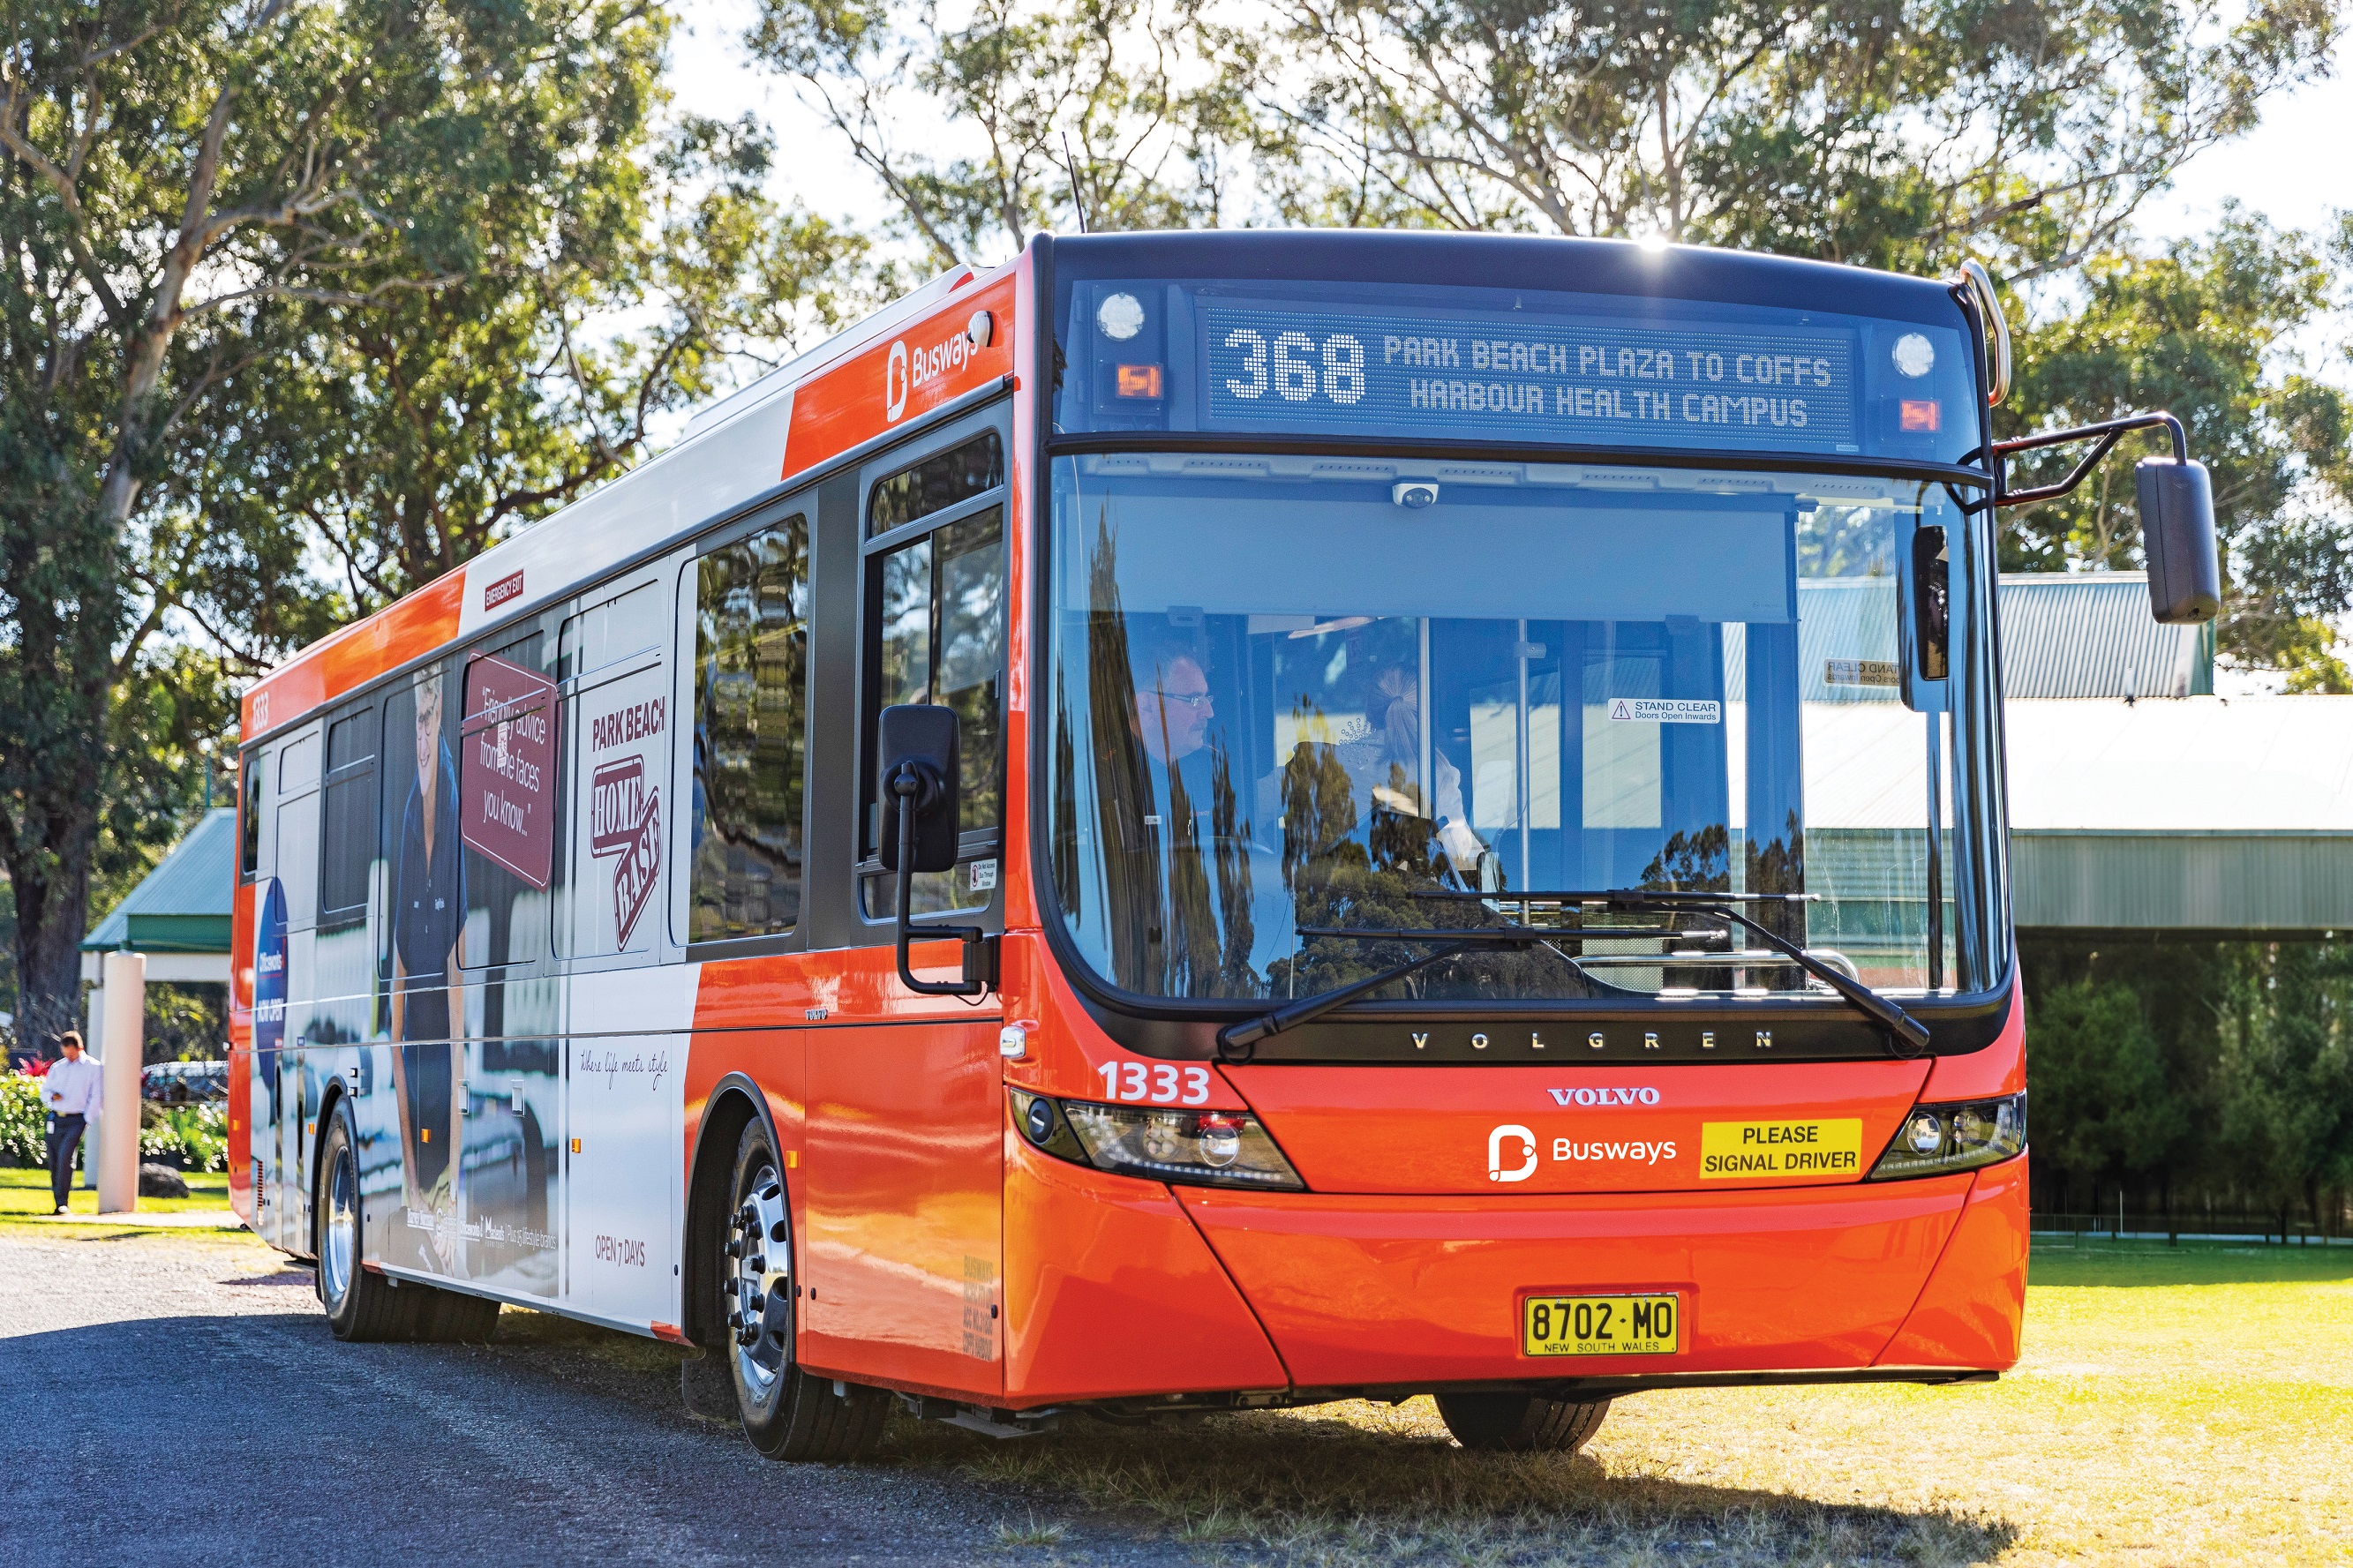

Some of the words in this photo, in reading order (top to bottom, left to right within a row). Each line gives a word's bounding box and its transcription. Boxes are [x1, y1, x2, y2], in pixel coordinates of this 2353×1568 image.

[1225, 327, 1366, 405] 368
[1383, 334, 1461, 369] PARK
[1472, 338, 1568, 374] BEACH
[1579, 343, 1674, 379] PLAZA
[1687, 349, 1725, 382] TO
[1735, 353, 1833, 387] COFFS
[1411, 376, 1544, 414] HARBOUR
[1557, 385, 1671, 421] HEALTH
[1682, 392, 1809, 428] CAMPUS
[486, 579, 512, 607] EMERGENCY
[512, 574, 522, 594] EXIT
[252, 691, 269, 731] 1333
[515, 703, 545, 745] advice
[592, 709, 625, 752] PARK
[626, 695, 665, 744] BEACH
[1635, 701, 1674, 711] STAND
[1677, 702, 1717, 712] CLEAR
[1635, 710, 1659, 719] Doors
[1661, 711, 1683, 721] Open
[1685, 712, 1717, 721] Inwards
[480, 732, 500, 773] from
[516, 748, 540, 792] faces
[483, 790, 500, 823] you
[593, 776, 642, 838] HOME
[616, 812, 660, 927] BASE
[1411, 1030, 1773, 1050] VOLGREN
[580, 1049, 603, 1072] Where
[605, 1051, 619, 1091] life
[621, 1053, 644, 1072] meets
[647, 1050, 669, 1092] style
[1097, 1061, 1210, 1105] 1333
[1546, 1085, 1661, 1107] VOLVO
[1552, 1137, 1678, 1167] Busways
[1742, 1125, 1819, 1146] PLEASE
[1704, 1152, 1779, 1173] SIGNAL
[1784, 1149, 1856, 1171] DRIVER
[595, 1234, 617, 1263] OPEN
[618, 1242, 623, 1267] 7
[624, 1238, 645, 1267] DAYS
[1544, 1342, 1570, 1353] NEW
[1576, 1341, 1616, 1353] SOUTH
[1621, 1340, 1660, 1352] WALES
